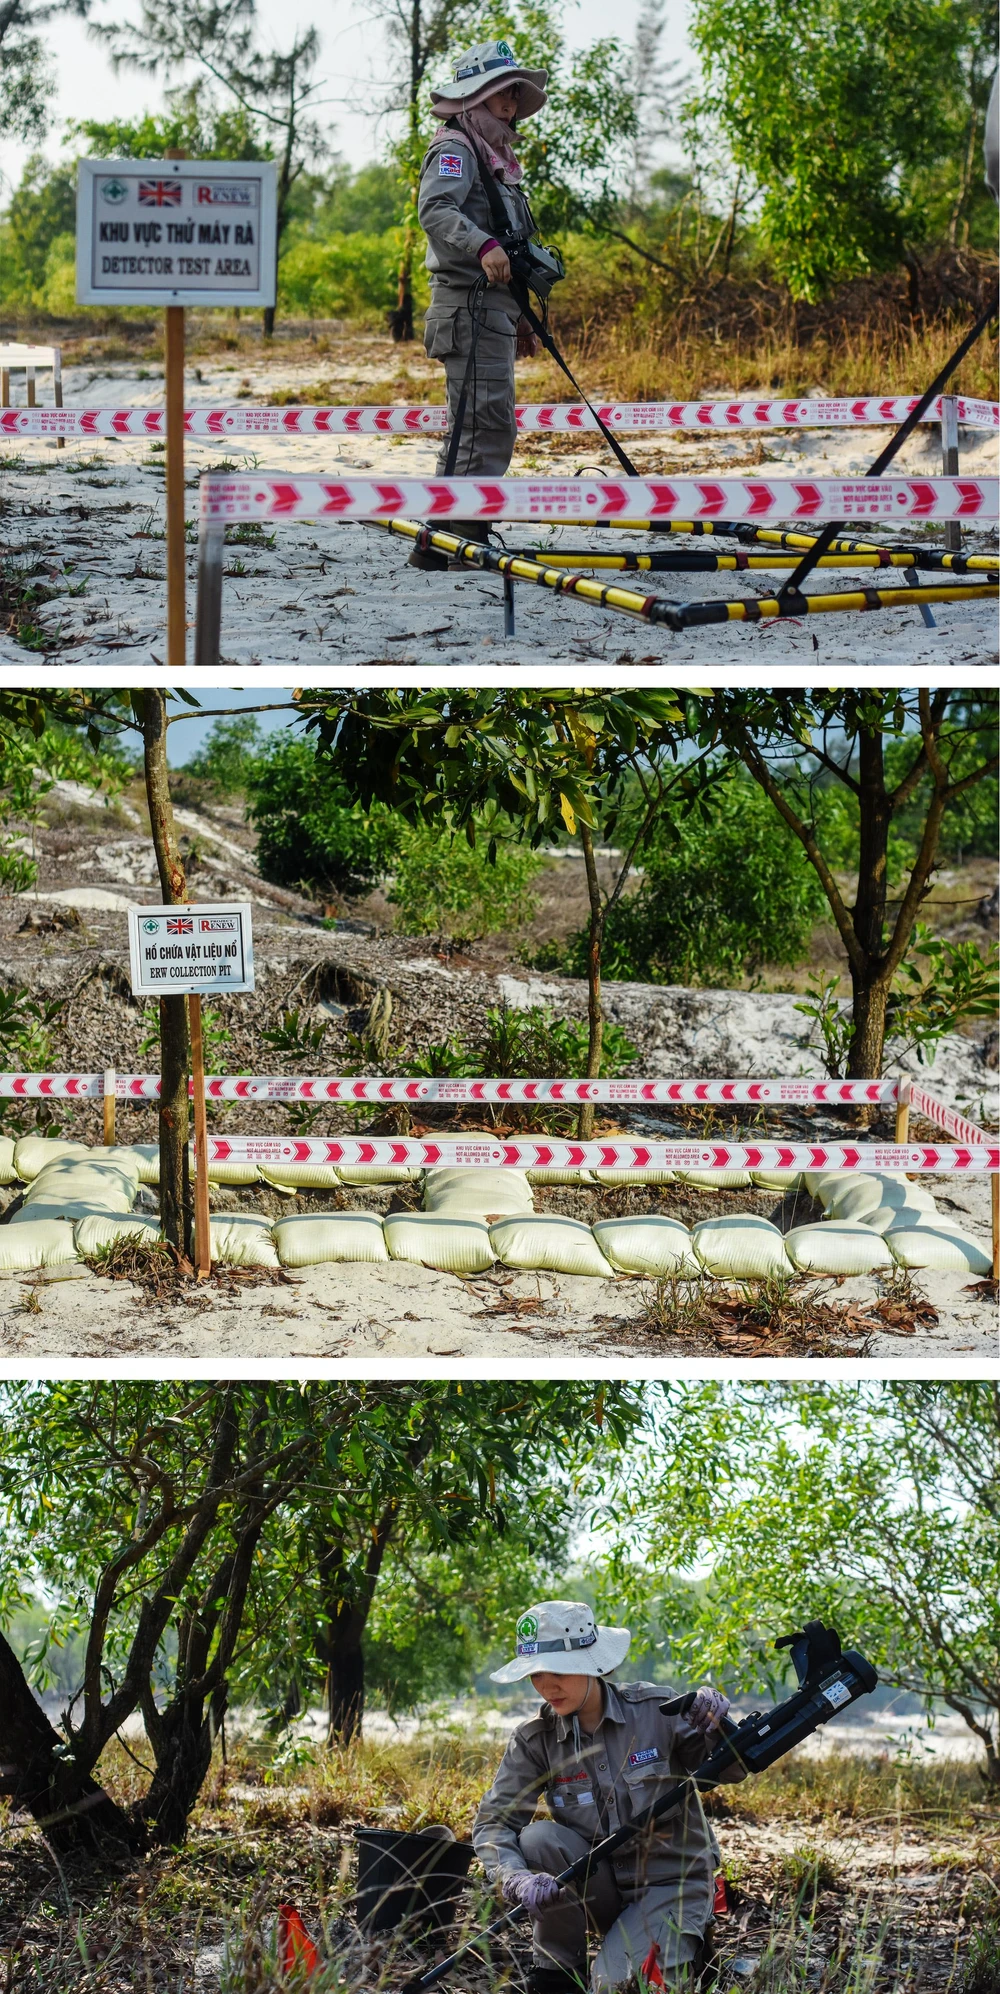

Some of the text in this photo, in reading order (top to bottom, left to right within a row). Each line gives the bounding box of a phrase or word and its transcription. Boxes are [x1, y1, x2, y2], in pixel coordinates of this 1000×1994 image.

[197, 186, 251, 204] RENEW
[99, 216, 254, 248] KHU VỰC THỬ MÁY RÀ
[101, 256, 251, 277] DETECTOR TEST AREA
[202, 920, 235, 932] RENEW
[145, 939, 238, 961] HỐ CHỨA VẬT LIỆU NỔ
[150, 965, 232, 979] ERW COLLECTION PIT
